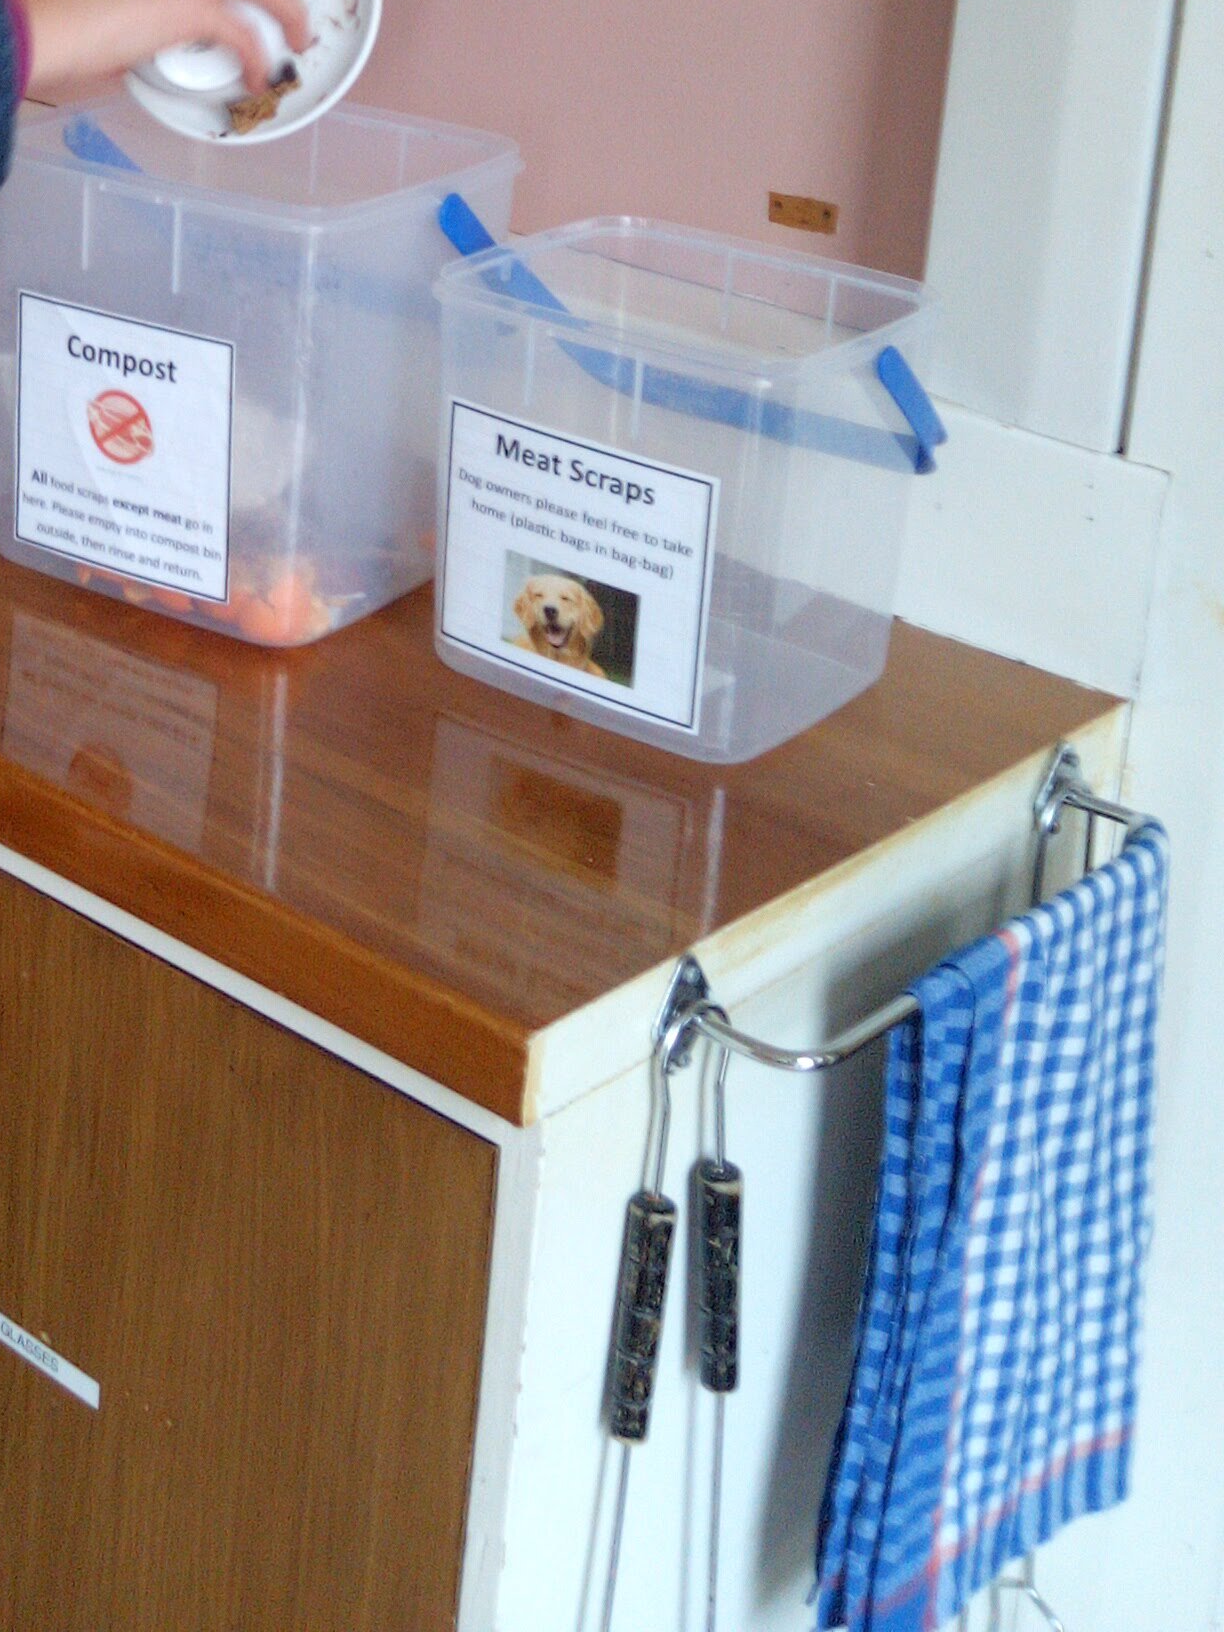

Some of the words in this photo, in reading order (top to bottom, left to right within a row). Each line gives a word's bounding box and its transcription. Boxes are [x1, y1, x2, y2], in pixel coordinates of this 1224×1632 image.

[67, 334, 177, 384] Compost
[496, 433, 561, 476] Meat
[569, 458, 656, 506] Scraps
[31, 469, 48, 486] All
[49, 476, 75, 494] food
[112, 497, 149, 516] except
[152, 508, 182, 525] meat
[184, 517, 199, 531] go
[201, 520, 214, 535] in
[52, 499, 86, 521] Please
[88, 515, 122, 536] empty
[124, 524, 149, 540] into
[150, 533, 200, 557] compost
[202, 544, 222, 562] bin
[458, 467, 483, 490] Dog
[485, 480, 533, 505] owners
[535, 497, 579, 521] please
[582, 510, 608, 530] feel
[611, 520, 640, 542] free
[642, 532, 660, 547] to
[662, 537, 694, 558] take
[81, 536, 107, 553] then
[138, 554, 161, 569] and
[471, 497, 507, 523] home
[510, 512, 557, 541] (plastic
[559, 529, 591, 552] bags
[594, 542, 608, 556] in
[611, 547, 675, 581] bag-bag)
[0, 1320, 60, 1373] GLASSES
